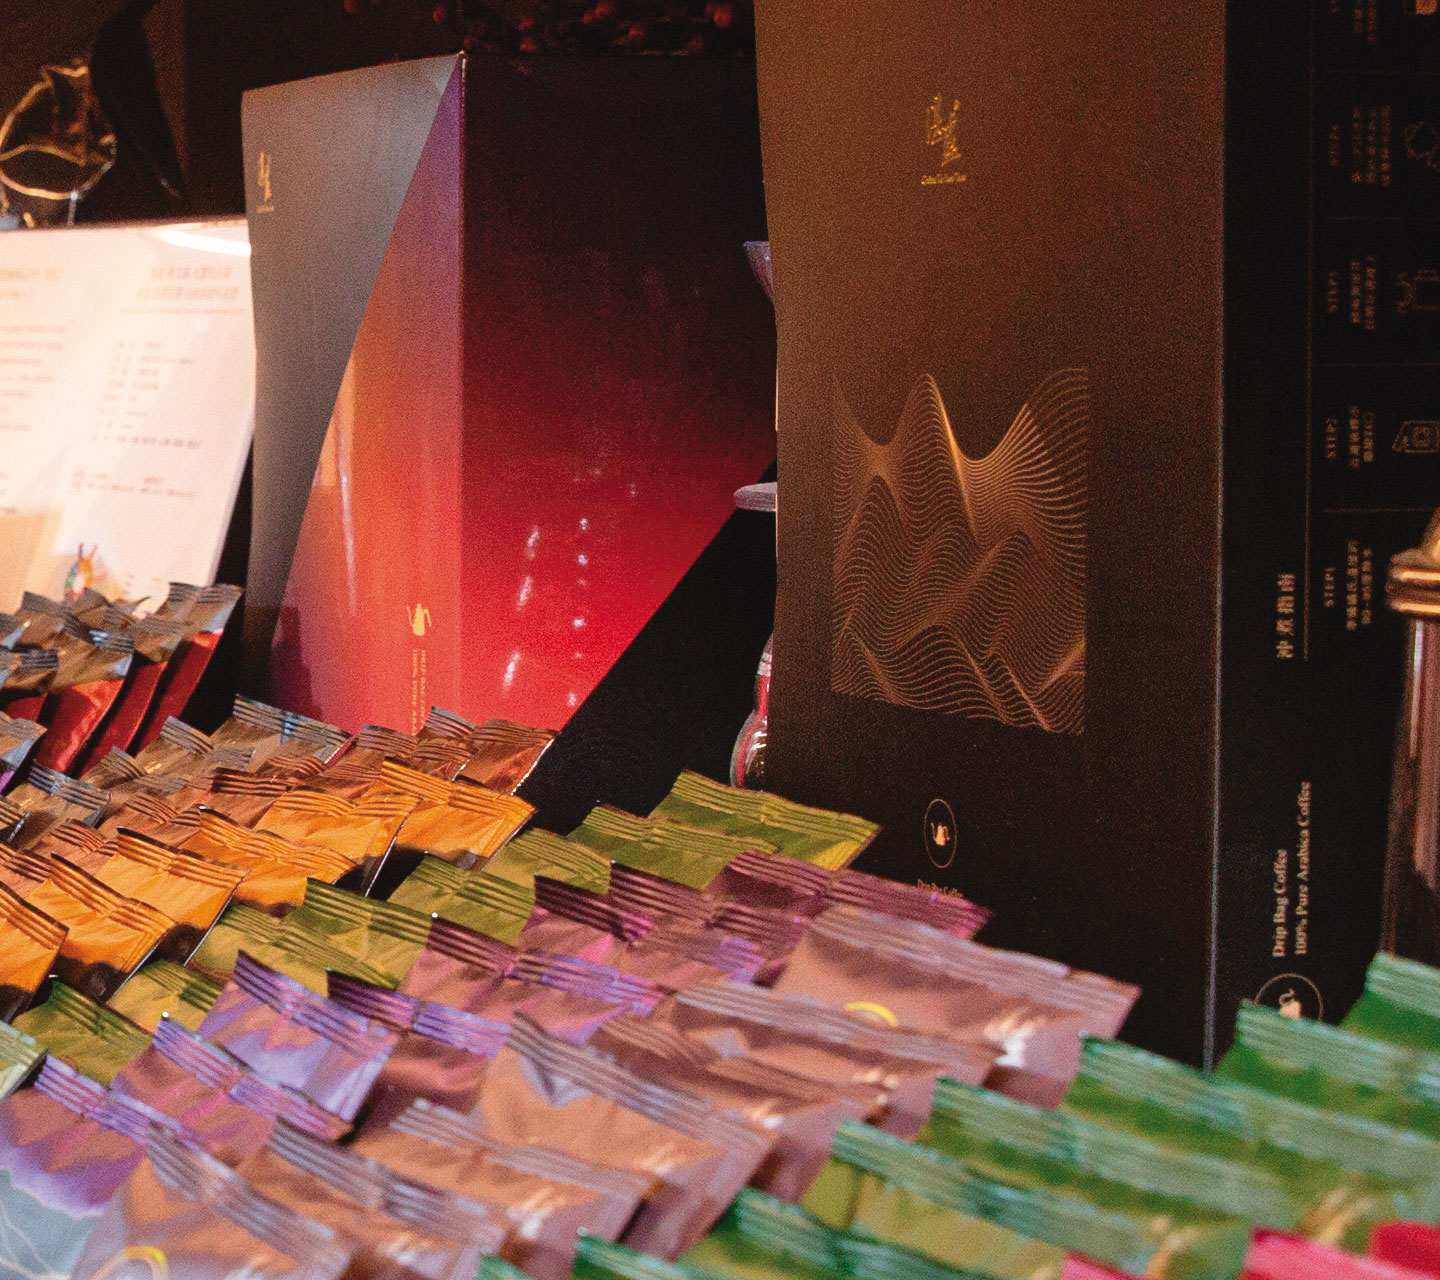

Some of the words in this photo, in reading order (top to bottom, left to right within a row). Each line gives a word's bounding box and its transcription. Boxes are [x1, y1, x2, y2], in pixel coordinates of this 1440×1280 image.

[1296, 781, 1312, 828] Coffee
[1273, 849, 1288, 895] Coffee
[1295, 829, 1310, 882] Arabica
[1273, 897, 1290, 924] Bag
[1295, 884, 1309, 916] Pure
[1272, 926, 1289, 958] Drip
[1294, 919, 1308, 956] 100%
